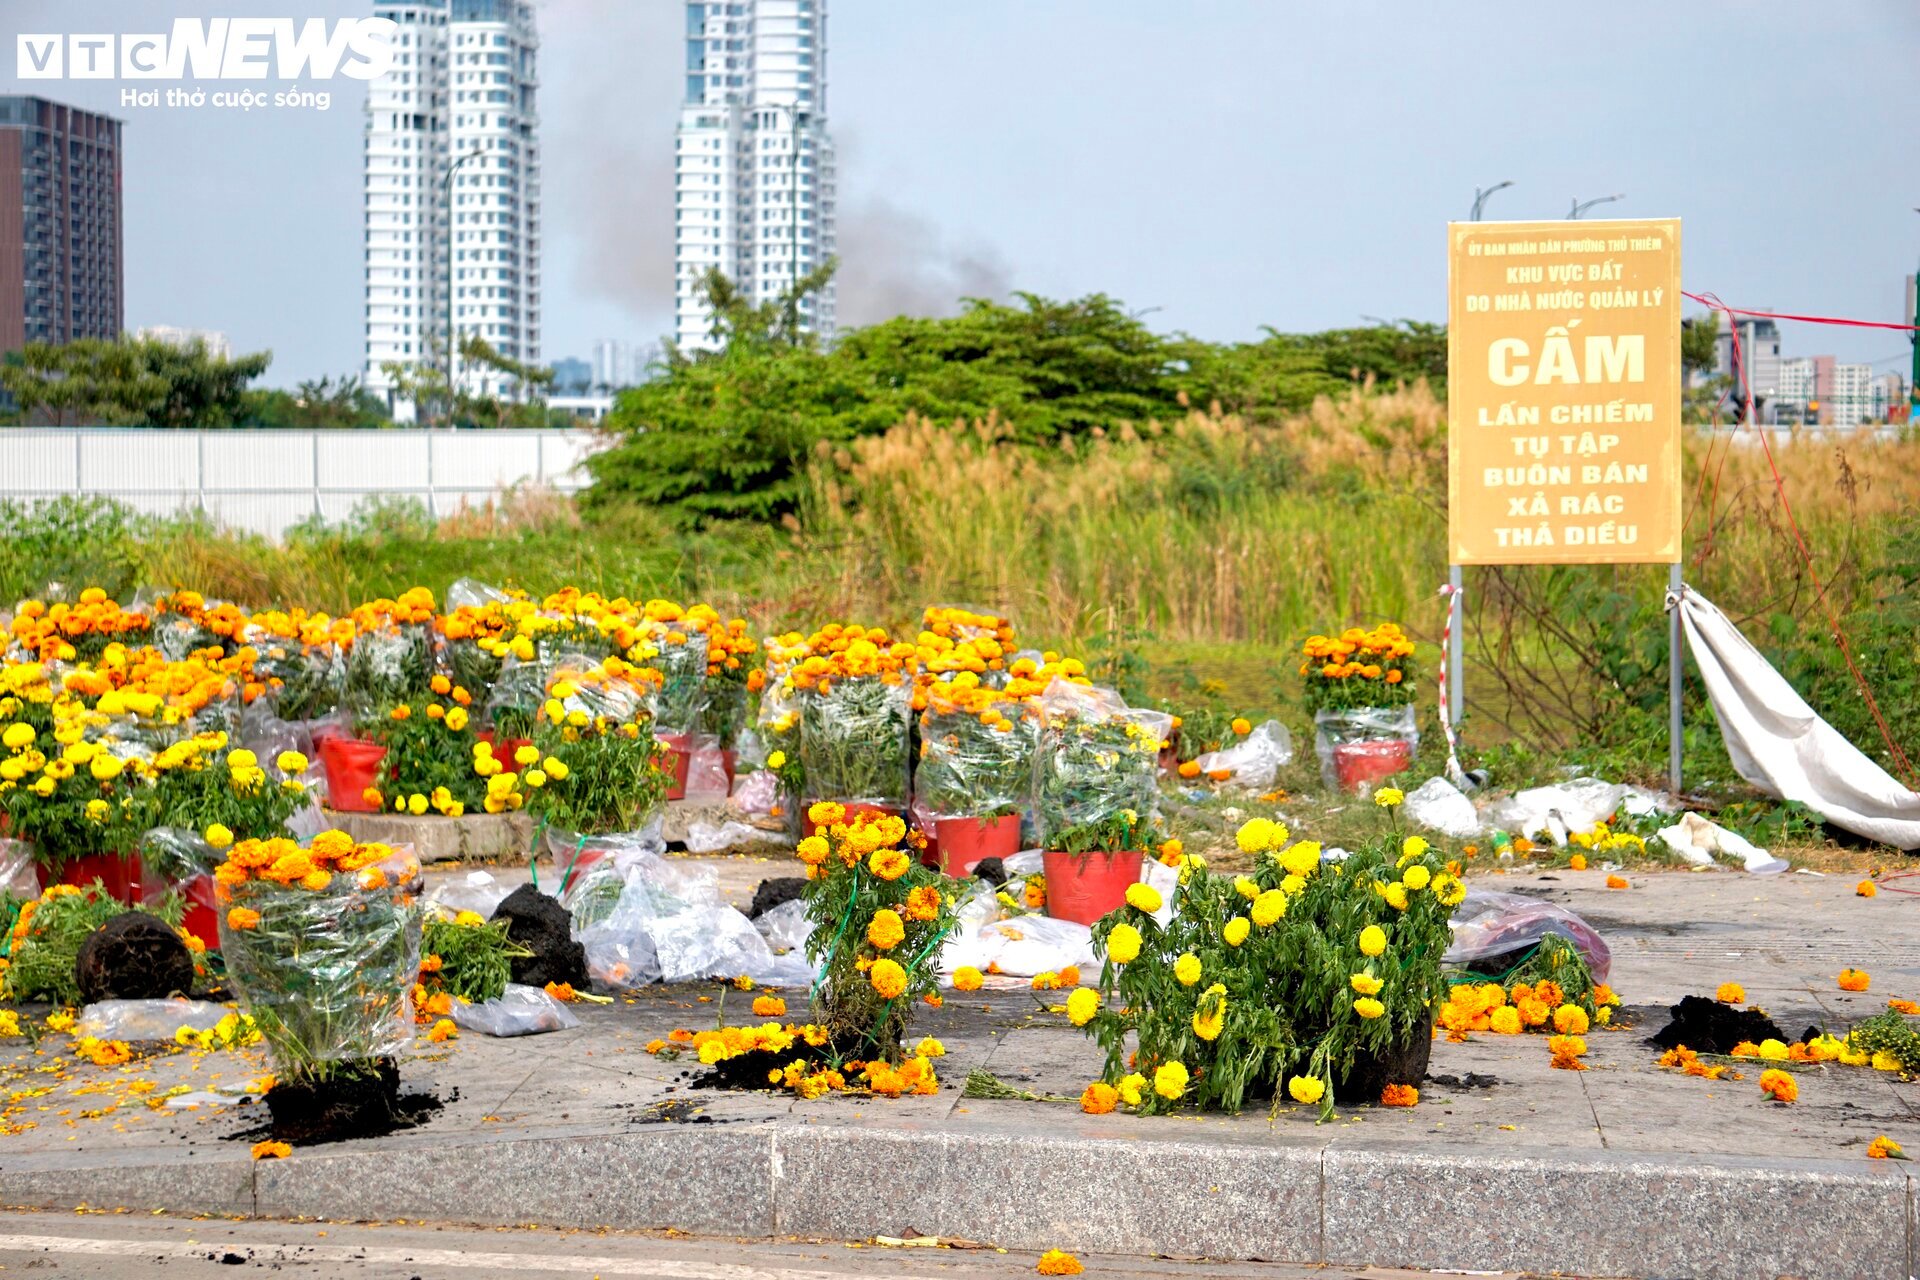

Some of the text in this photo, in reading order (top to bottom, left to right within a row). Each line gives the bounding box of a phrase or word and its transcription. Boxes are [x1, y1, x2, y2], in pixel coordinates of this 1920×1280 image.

[1469, 236, 1661, 256] ỦY BAN NHÂN DÂN PHƯỜNG THỦ THIÊM
[1507, 259, 1623, 285] KHU VỰC ĐẤT
[1467, 287, 1663, 311] DO NHÀ NƯỚC QUẢN LÝ
[1489, 319, 1644, 386] CẤM
[1479, 398, 1653, 426] LẤN CHIẾM
[1511, 432, 1619, 458] TỤ TẬP
[1484, 462, 1647, 486] BUÔN BÁN
[1508, 492, 1623, 516] XẢ RÁC
[1494, 521, 1637, 547] THẢ DIỀU
